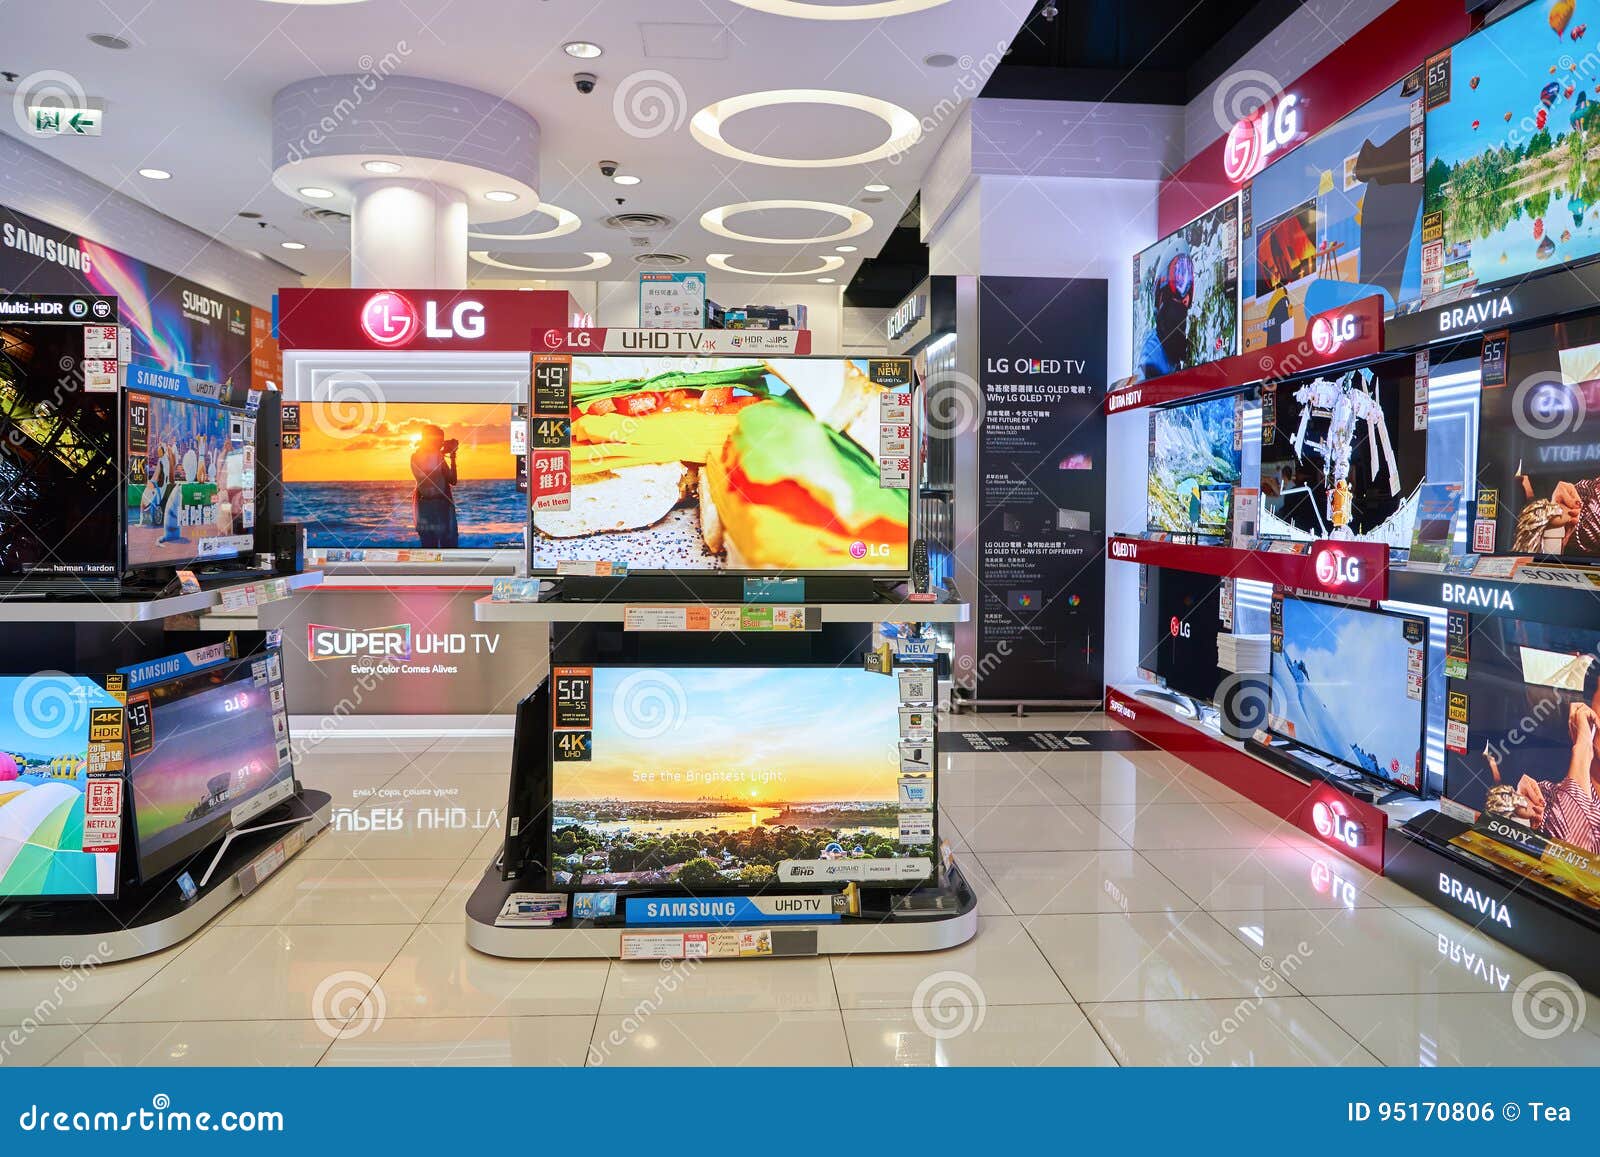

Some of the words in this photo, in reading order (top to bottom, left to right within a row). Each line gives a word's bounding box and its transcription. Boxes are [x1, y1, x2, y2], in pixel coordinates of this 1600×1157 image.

[1261, 93, 1297, 155] LG
[1424, 214, 1440, 226] 4K
[1424, 228, 1441, 240] HDR
[3, 222, 92, 275] SAMSUNG
[426, 301, 485, 338] LG
[1439, 296, 1513, 331] BRAVIA
[1334, 314, 1354, 342] LG
[567, 332, 591, 346] LG
[622, 332, 669, 349] UHD
[672, 332, 703, 349] TV
[702, 340, 716, 350] 4K
[877, 368, 901, 376] NEW
[987, 358, 1009, 373] LG
[1014, 358, 1060, 374] OLED
[1064, 360, 1085, 374] TV
[137, 371, 180, 391] SAMSUNG
[537, 367, 568, 387] 49"
[1034, 385, 1045, 393] LG
[1047, 385, 1069, 393] OLED
[987, 394, 1004, 403] Why
[1007, 394, 1018, 402] LG
[1020, 394, 1042, 402] OLED
[537, 420, 565, 437] 4K
[537, 500, 551, 509] Hot
[551, 498, 569, 507] Item
[1479, 493, 1495, 502] 4K
[870, 544, 890, 557] LG
[1338, 556, 1359, 583] LG
[1521, 569, 1582, 583] SONY
[1442, 583, 1515, 611] BRAVIA
[1180, 621, 1191, 638] LG
[317, 632, 402, 655] SUPER
[415, 633, 466, 654] UHD
[470, 634, 499, 654] TV
[905, 644, 930, 654] NEW
[131, 658, 180, 683] SAMSUNG
[351, 665, 375, 674] Every
[376, 665, 400, 673] Color
[401, 665, 431, 673] Comes
[432, 665, 457, 673] Alives
[558, 680, 589, 700] 50"
[575, 701, 586, 710] 55
[1451, 696, 1464, 705] 4K
[95, 711, 120, 722] 4K
[1451, 707, 1466, 719] HDR
[93, 727, 120, 737] HDR
[559, 734, 586, 751] 4K
[564, 750, 581, 758] UHD
[89, 763, 107, 773] NEW
[632, 769, 655, 782] See
[660, 769, 681, 782] the
[686, 769, 745, 783] Brightest
[93, 785, 114, 796] 日本
[92, 796, 113, 807] 製造
[87, 819, 116, 830] NETFLIX
[1334, 812, 1358, 848] LG
[1488, 820, 1533, 845] SONY
[575, 896, 592, 908] 4K
[1439, 872, 1512, 929] BRAVIA
[647, 902, 736, 917] SAMSUNG
